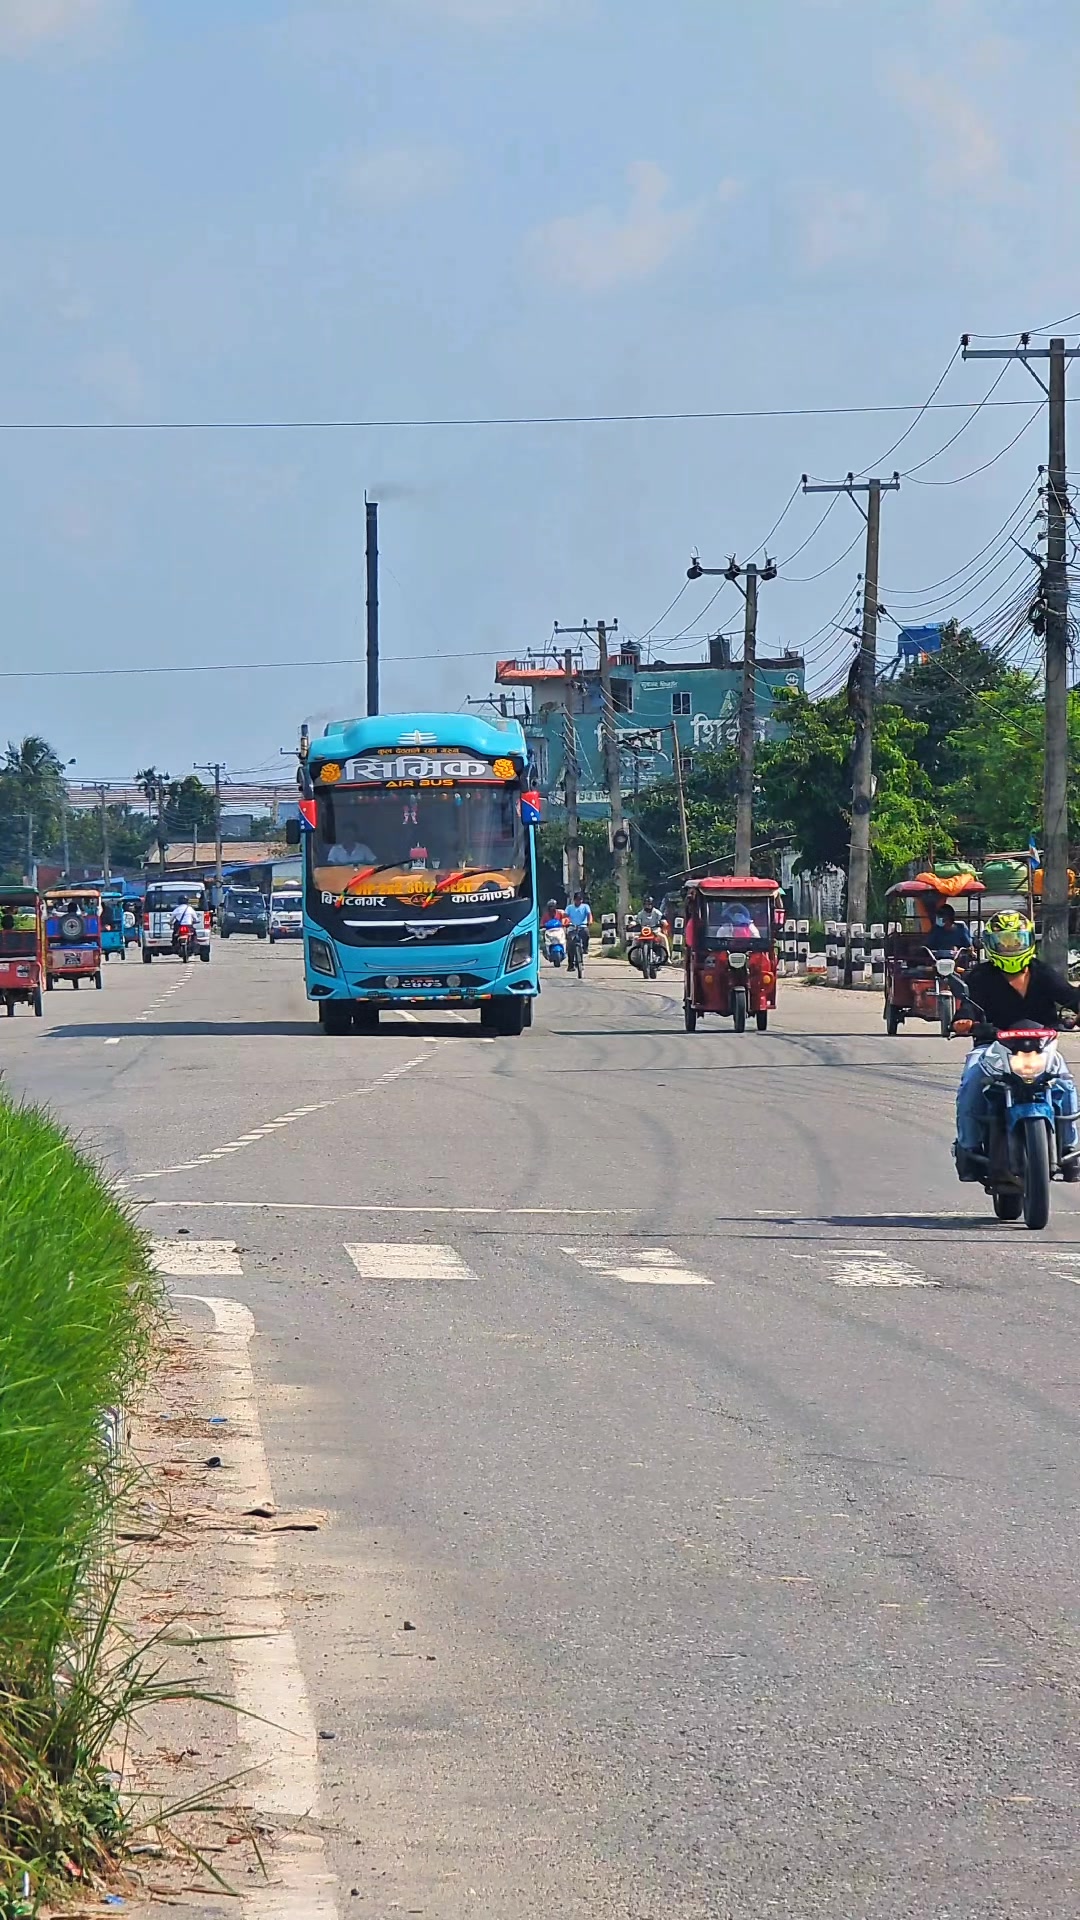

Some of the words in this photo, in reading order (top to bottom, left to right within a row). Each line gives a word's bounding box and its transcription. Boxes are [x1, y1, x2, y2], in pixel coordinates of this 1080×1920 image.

[345, 755, 489, 780] सिम्रिक
[385, 780, 414, 788] AIR
[419, 779, 454, 787] BUS
